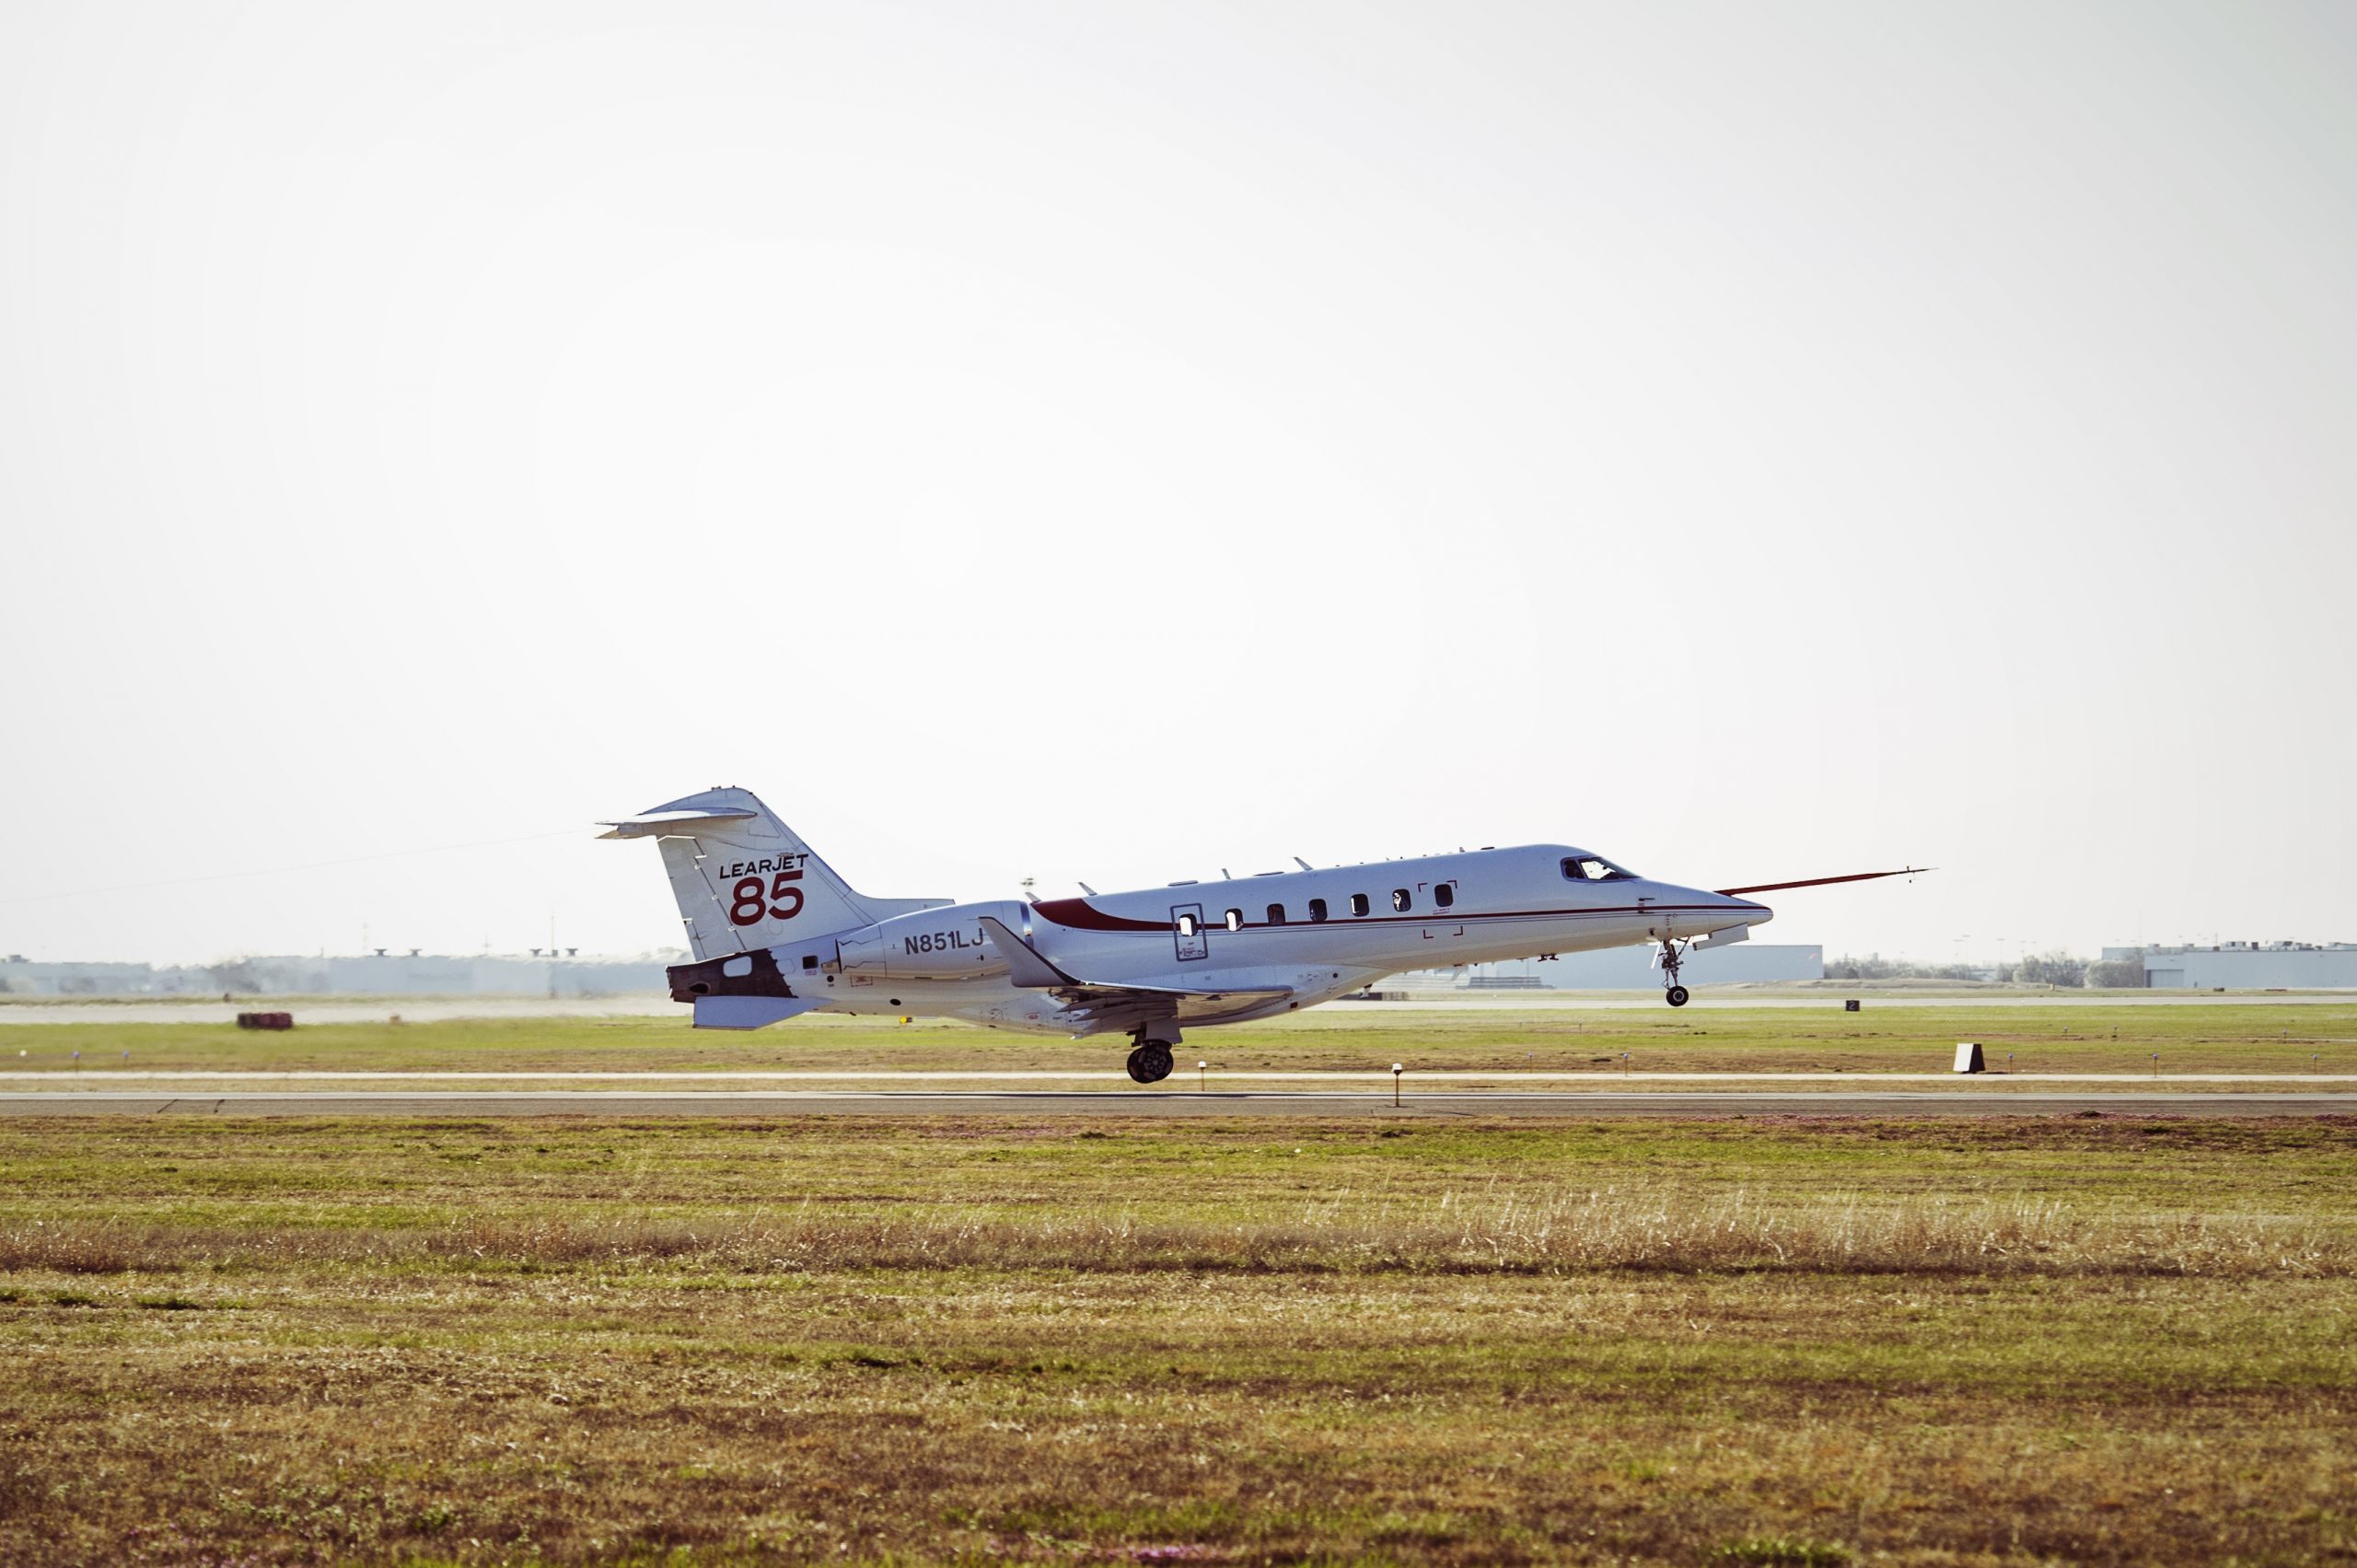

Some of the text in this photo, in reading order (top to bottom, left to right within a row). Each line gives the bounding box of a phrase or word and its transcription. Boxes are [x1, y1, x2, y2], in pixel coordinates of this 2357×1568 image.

[719, 853, 809, 879] LEARJET
[730, 869, 805, 926] 85
[904, 927, 984, 955] N851LJ
